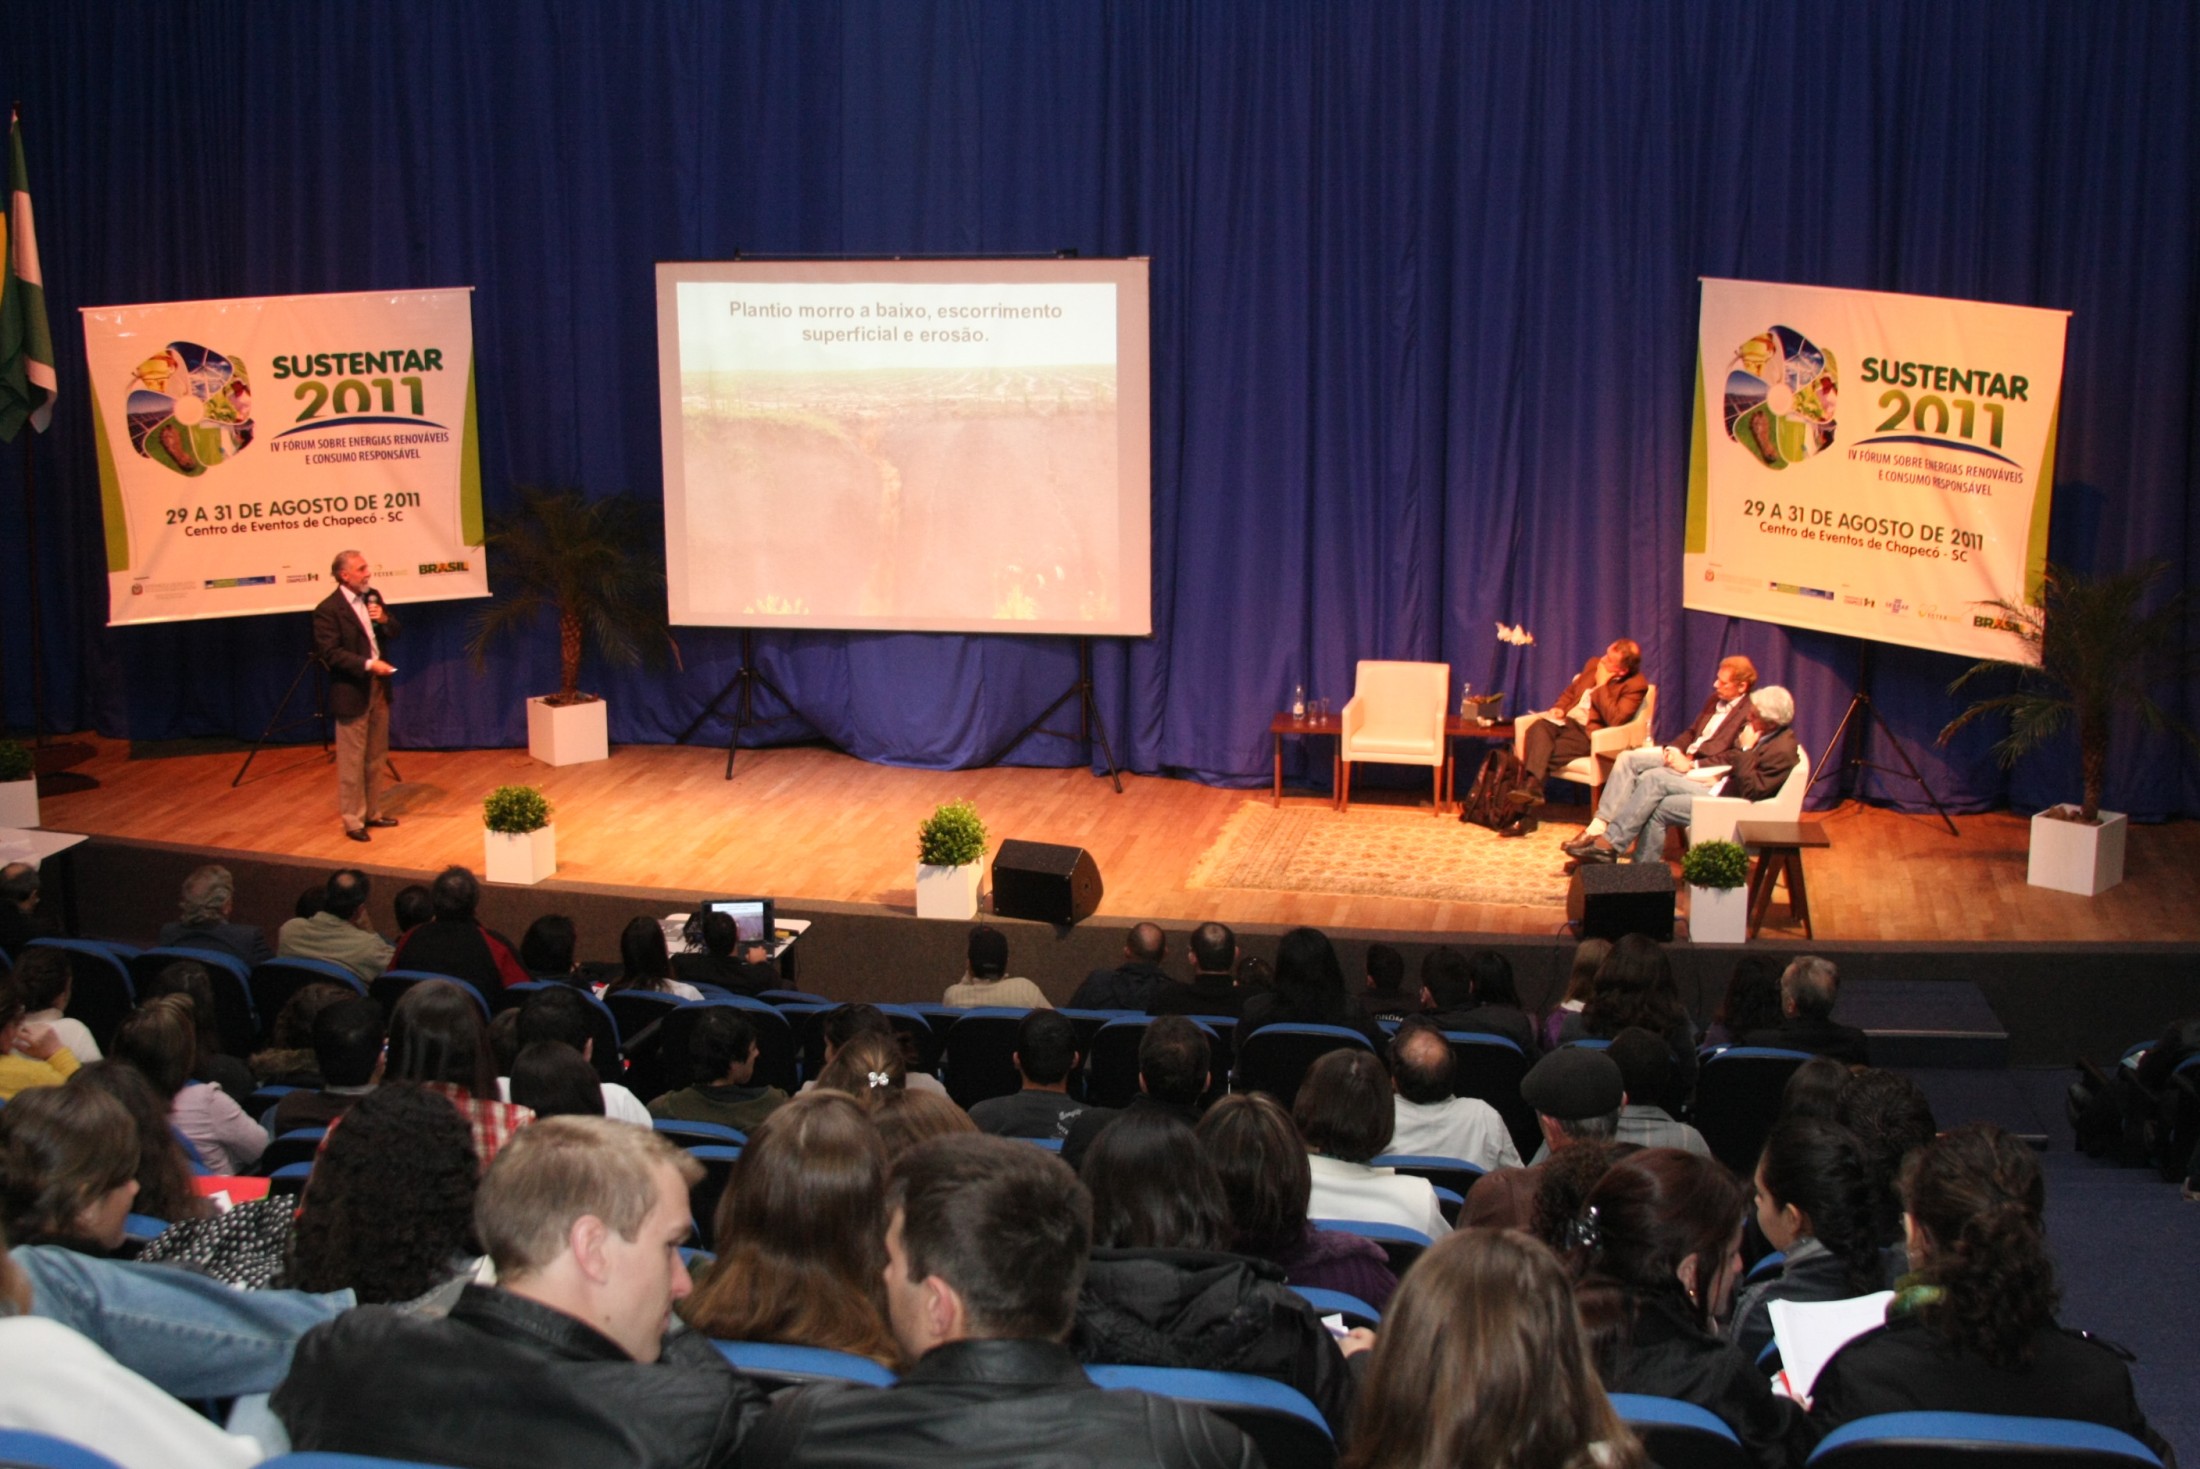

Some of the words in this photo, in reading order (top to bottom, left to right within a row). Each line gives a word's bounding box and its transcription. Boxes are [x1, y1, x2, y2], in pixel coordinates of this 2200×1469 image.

[729, 300, 793, 318] Plantio
[799, 304, 855, 319] morro
[860, 304, 870, 318] a
[876, 301, 932, 321] baixo,
[937, 302, 1063, 319] escorrimento
[802, 326, 898, 344] superficial
[903, 329, 914, 342] e
[919, 327, 990, 343] erosão.
[272, 348, 443, 379] SUSTENTAR
[1861, 357, 2029, 401] SUSTENTAR
[294, 376, 424, 423] 2011
[1875, 389, 2004, 449] 2011
[270, 442, 280, 452] IV
[283, 438, 316, 452] FÓRUM
[318, 437, 347, 449] SOBRE
[349, 435, 392, 448] ENERGIAS
[394, 431, 449, 445] RENOVÁVEIS
[305, 455, 310, 465] E
[313, 452, 357, 464] CONSUMO
[359, 448, 421, 461] RESPONSÁVEL
[1848, 450, 1857, 460] IV
[1859, 449, 1891, 464] FÓRUM
[1893, 455, 1922, 469] SOBRE
[1924, 459, 1963, 476] ENERGIAS
[1966, 465, 2023, 484] RENOVÁVEIS
[1878, 470, 1883, 481] E
[1885, 471, 1931, 486] CONSUMO
[1932, 476, 1992, 496] RESPONSÁVEL
[166, 508, 188, 525] 29
[194, 507, 208, 522] A
[214, 505, 232, 521] 31
[239, 503, 263, 519] DE
[269, 496, 348, 517] AGOSTO
[354, 495, 378, 511] DE
[383, 492, 421, 509] 2011
[185, 525, 227, 537] Centro
[231, 522, 247, 534] de
[251, 519, 299, 532] Eventos
[303, 517, 319, 528] de
[322, 512, 377, 527] Chapecó
[388, 511, 404, 522] SC
[1744, 499, 1765, 517] 29
[1770, 503, 1782, 520] A
[1788, 505, 1805, 523] 31
[1811, 508, 1833, 527] DE
[1838, 512, 1914, 539] AGOSTO
[1920, 524, 1944, 543] DE
[1950, 528, 1984, 551] 2011
[1760, 521, 1798, 537] Centro
[1801, 527, 1815, 540] de
[1819, 530, 1864, 548] Eventos
[1867, 537, 1882, 550] de
[1885, 540, 1940, 559] Chapecó
[1951, 549, 1968, 562] SC
[418, 561, 469, 575] BRASIL
[1973, 615, 2023, 634] BRASIL
